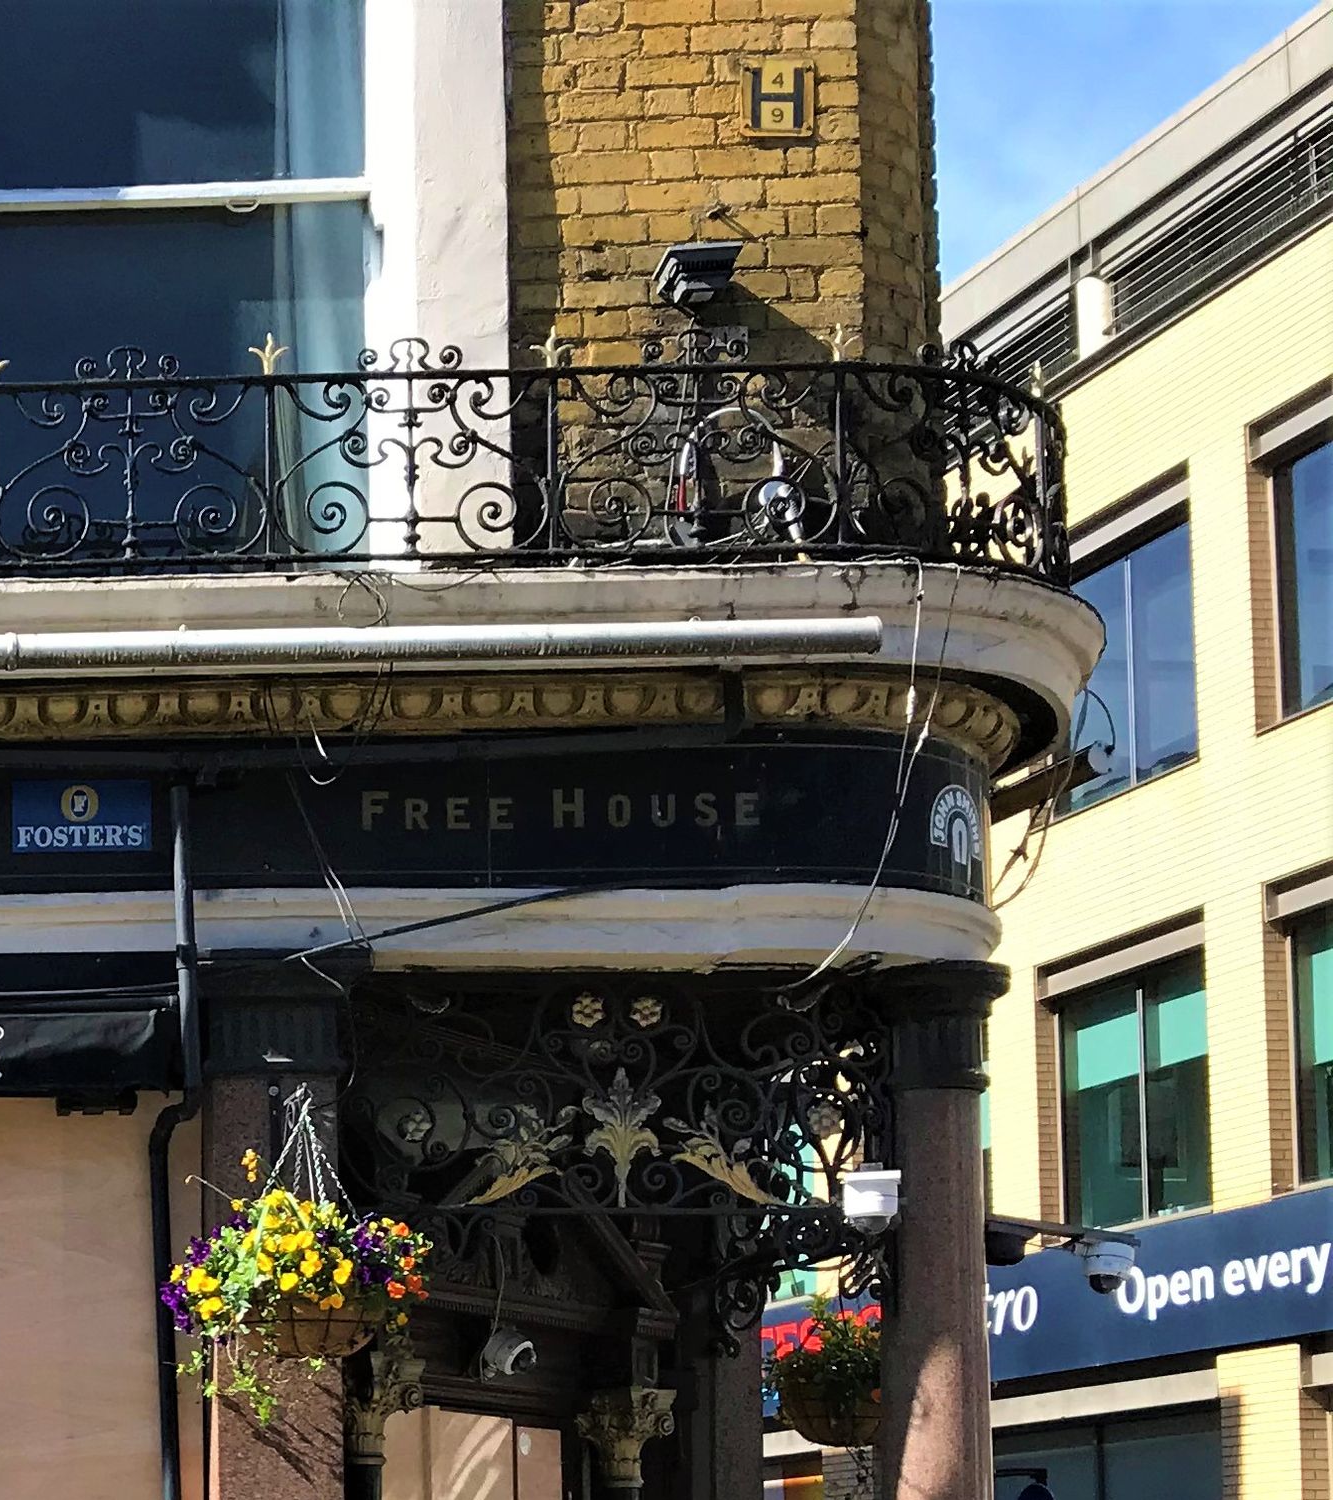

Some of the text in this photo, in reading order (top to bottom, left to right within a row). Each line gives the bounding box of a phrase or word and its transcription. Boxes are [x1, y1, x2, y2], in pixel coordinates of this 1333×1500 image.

[771, 71, 784, 89] 4
[771, 107, 784, 123] 9
[360, 787, 761, 831] FREE HOUSE
[17, 824, 143, 848] FOSTER'S
[1116, 1264, 1216, 1322] Open
[1222, 1242, 1332, 1295] every
